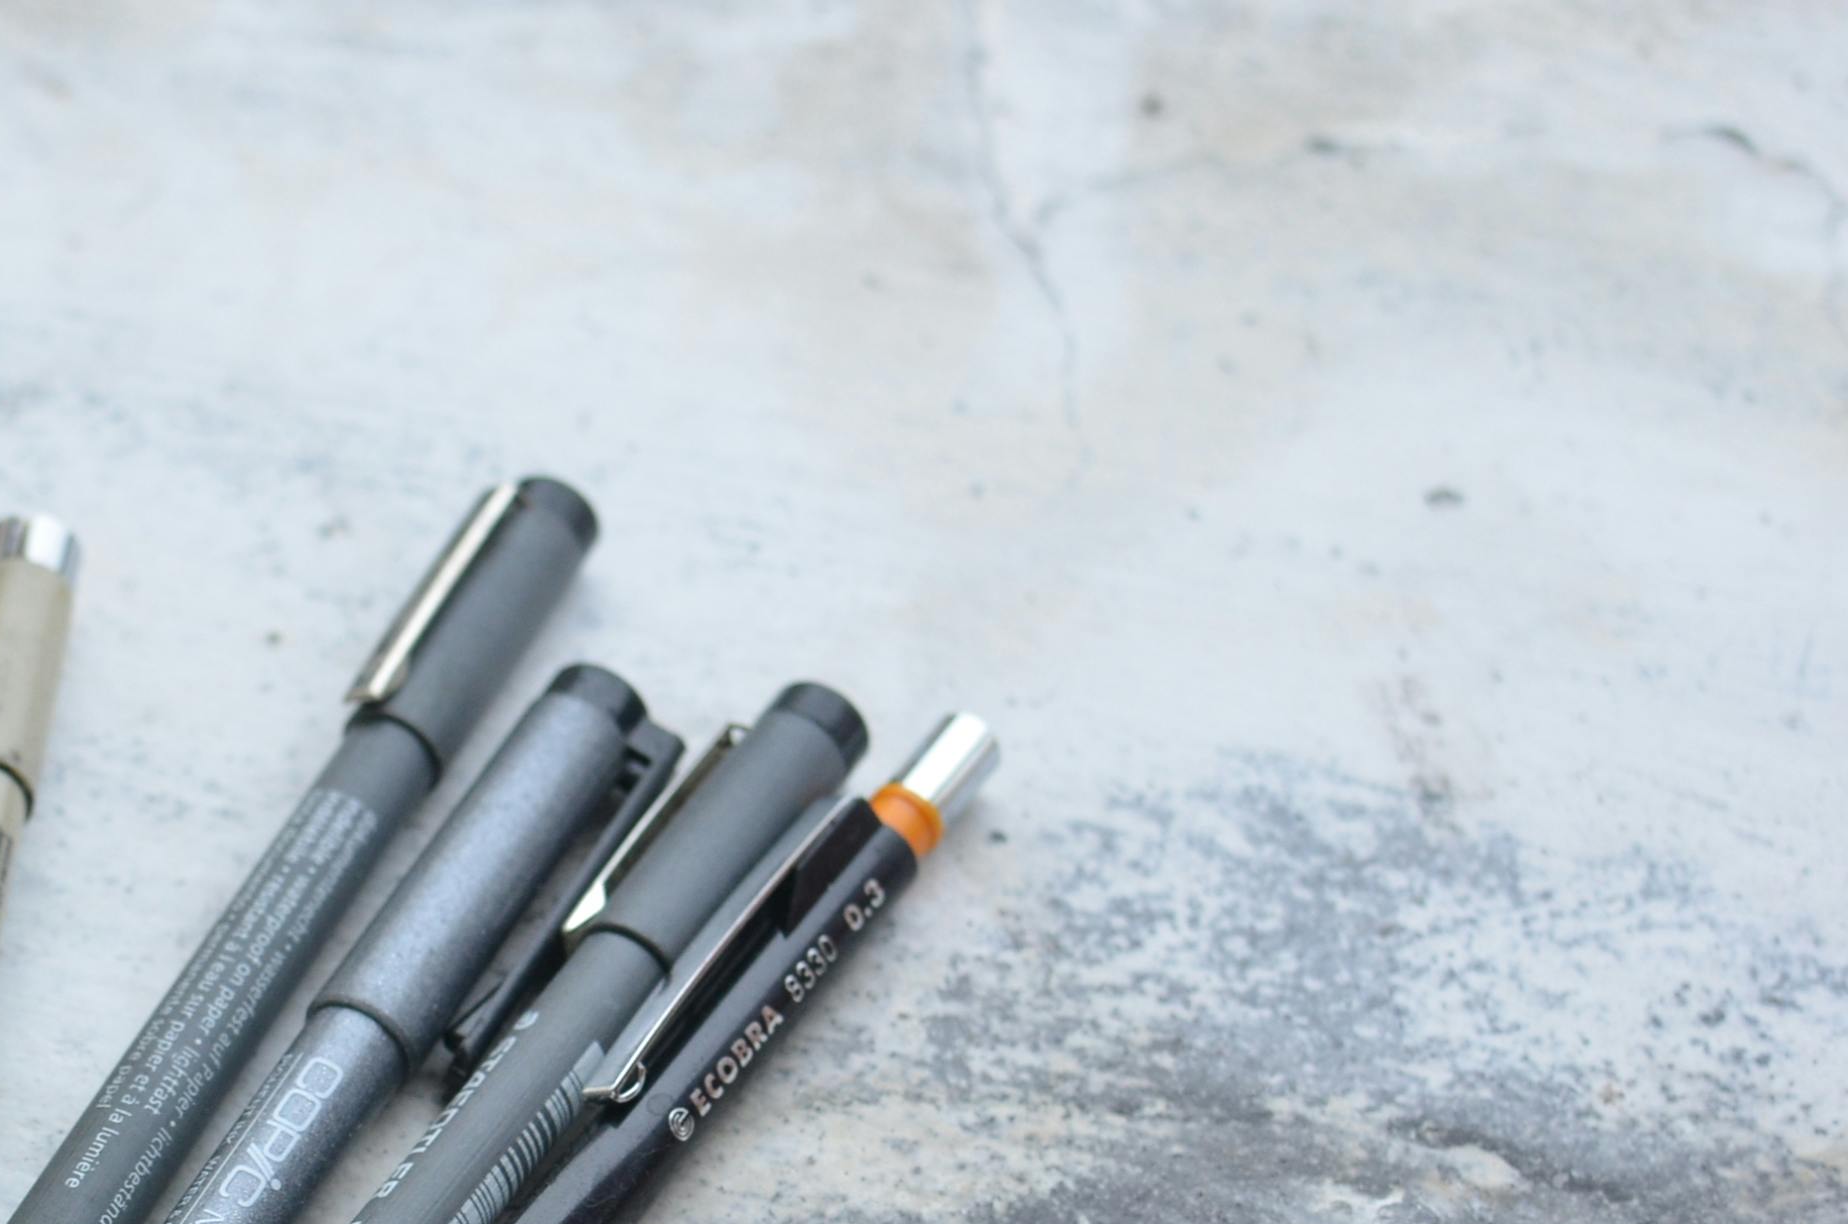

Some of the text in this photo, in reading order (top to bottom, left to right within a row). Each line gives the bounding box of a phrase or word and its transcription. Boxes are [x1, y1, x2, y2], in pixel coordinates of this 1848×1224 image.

[241, 869, 313, 967] waterproof
[225, 949, 288, 1036] wasserfest
[228, 963, 250, 987] on
[688, 874, 892, 1118] ECOBRA 8330 0.3
[179, 991, 204, 1019] sur
[192, 983, 237, 1037] paper
[140, 1015, 188, 1074] papier
[204, 1030, 236, 1066] auf
[117, 1091, 141, 1114] à
[127, 1071, 152, 1096] et
[139, 1041, 200, 1118] lightfast
[168, 1059, 216, 1118] Papier
[106, 1104, 131, 1129] la
[63, 1122, 119, 1195] lumière
